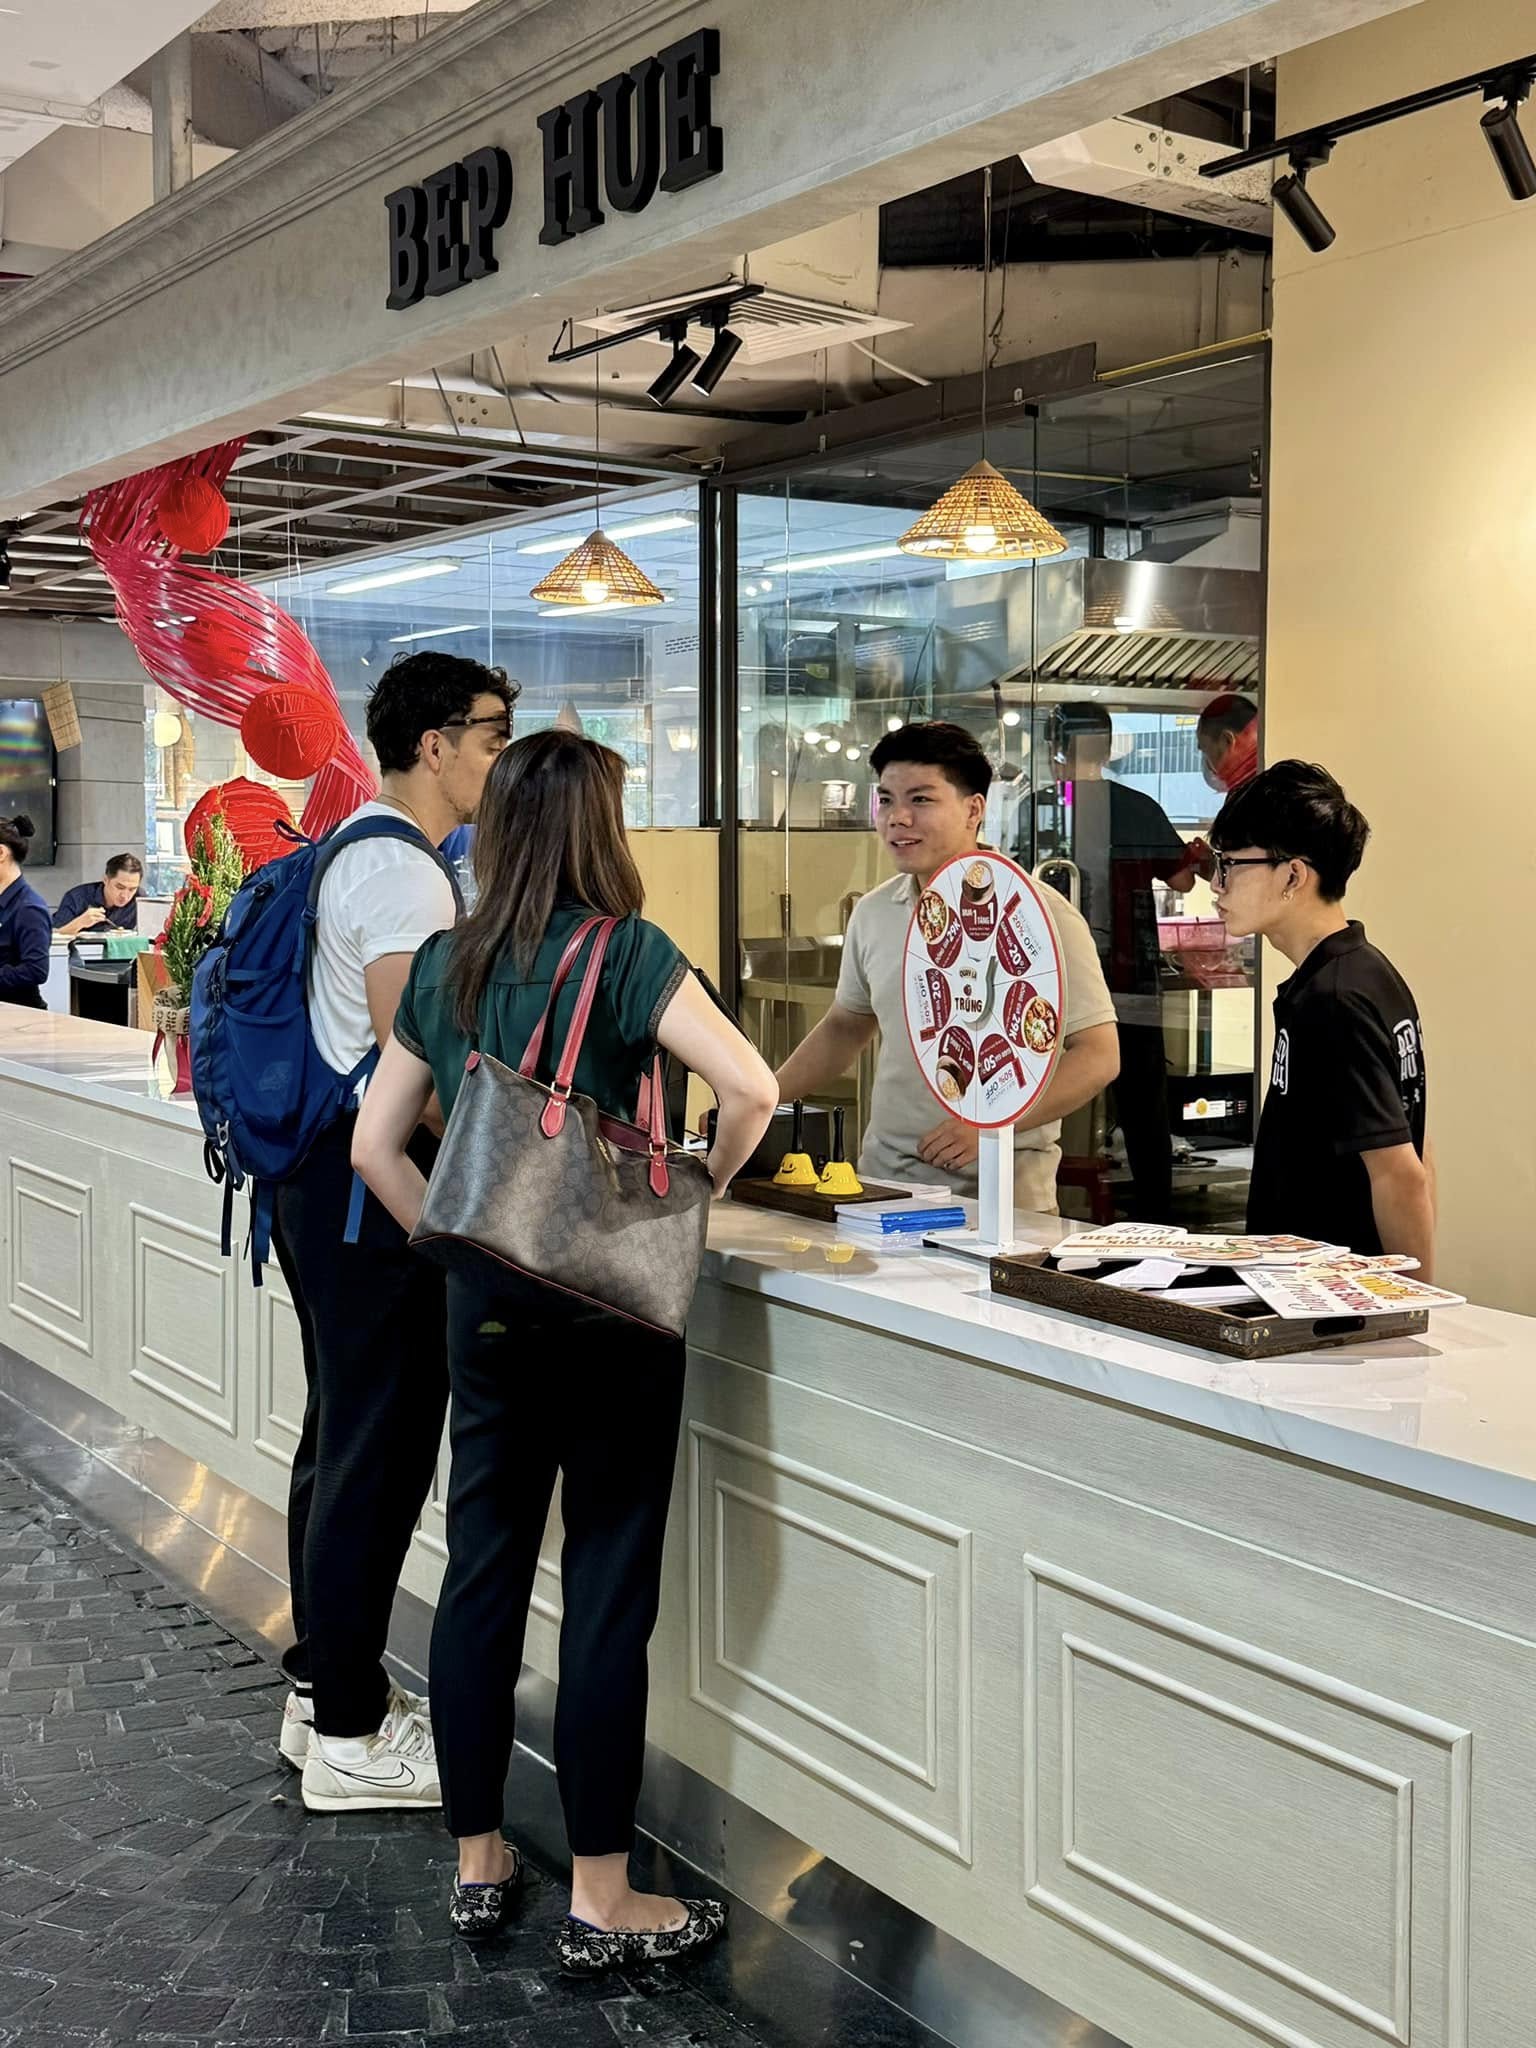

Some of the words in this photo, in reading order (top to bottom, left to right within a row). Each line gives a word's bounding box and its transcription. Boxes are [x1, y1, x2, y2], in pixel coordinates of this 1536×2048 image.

[384, 146, 513, 311] BEP
[536, 27, 724, 246] HUE
[1023, 936, 1039, 957] OFF
[985, 1081, 999, 1100] OFF
